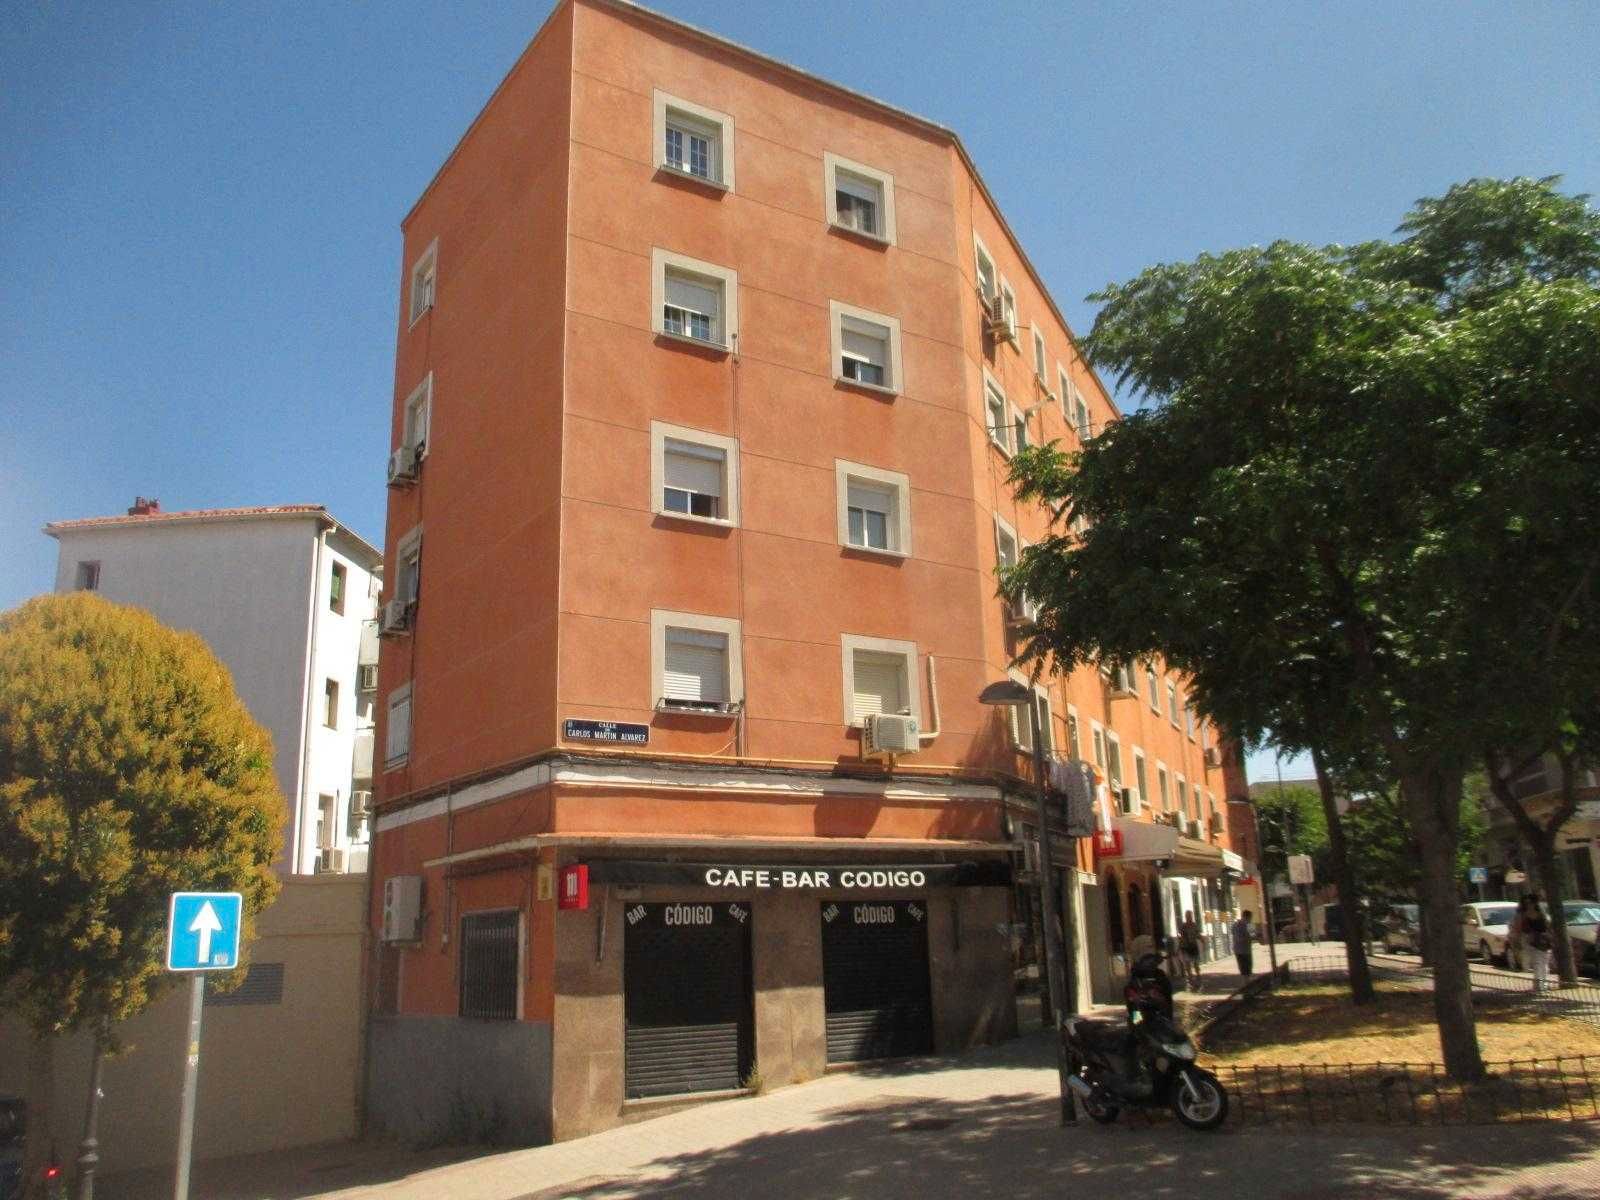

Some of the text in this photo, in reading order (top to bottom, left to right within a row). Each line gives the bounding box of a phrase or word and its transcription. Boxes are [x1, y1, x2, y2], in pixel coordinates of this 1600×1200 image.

[568, 729, 590, 738] CARLOS
[621, 733, 646, 742] ALVAREZ
[840, 870, 926, 888] CODIGO
[626, 904, 647, 925] BAR
[665, 903, 713, 925] CÓDIGO
[822, 904, 840, 923] BAR
[854, 904, 895, 924] CÓDIGO
